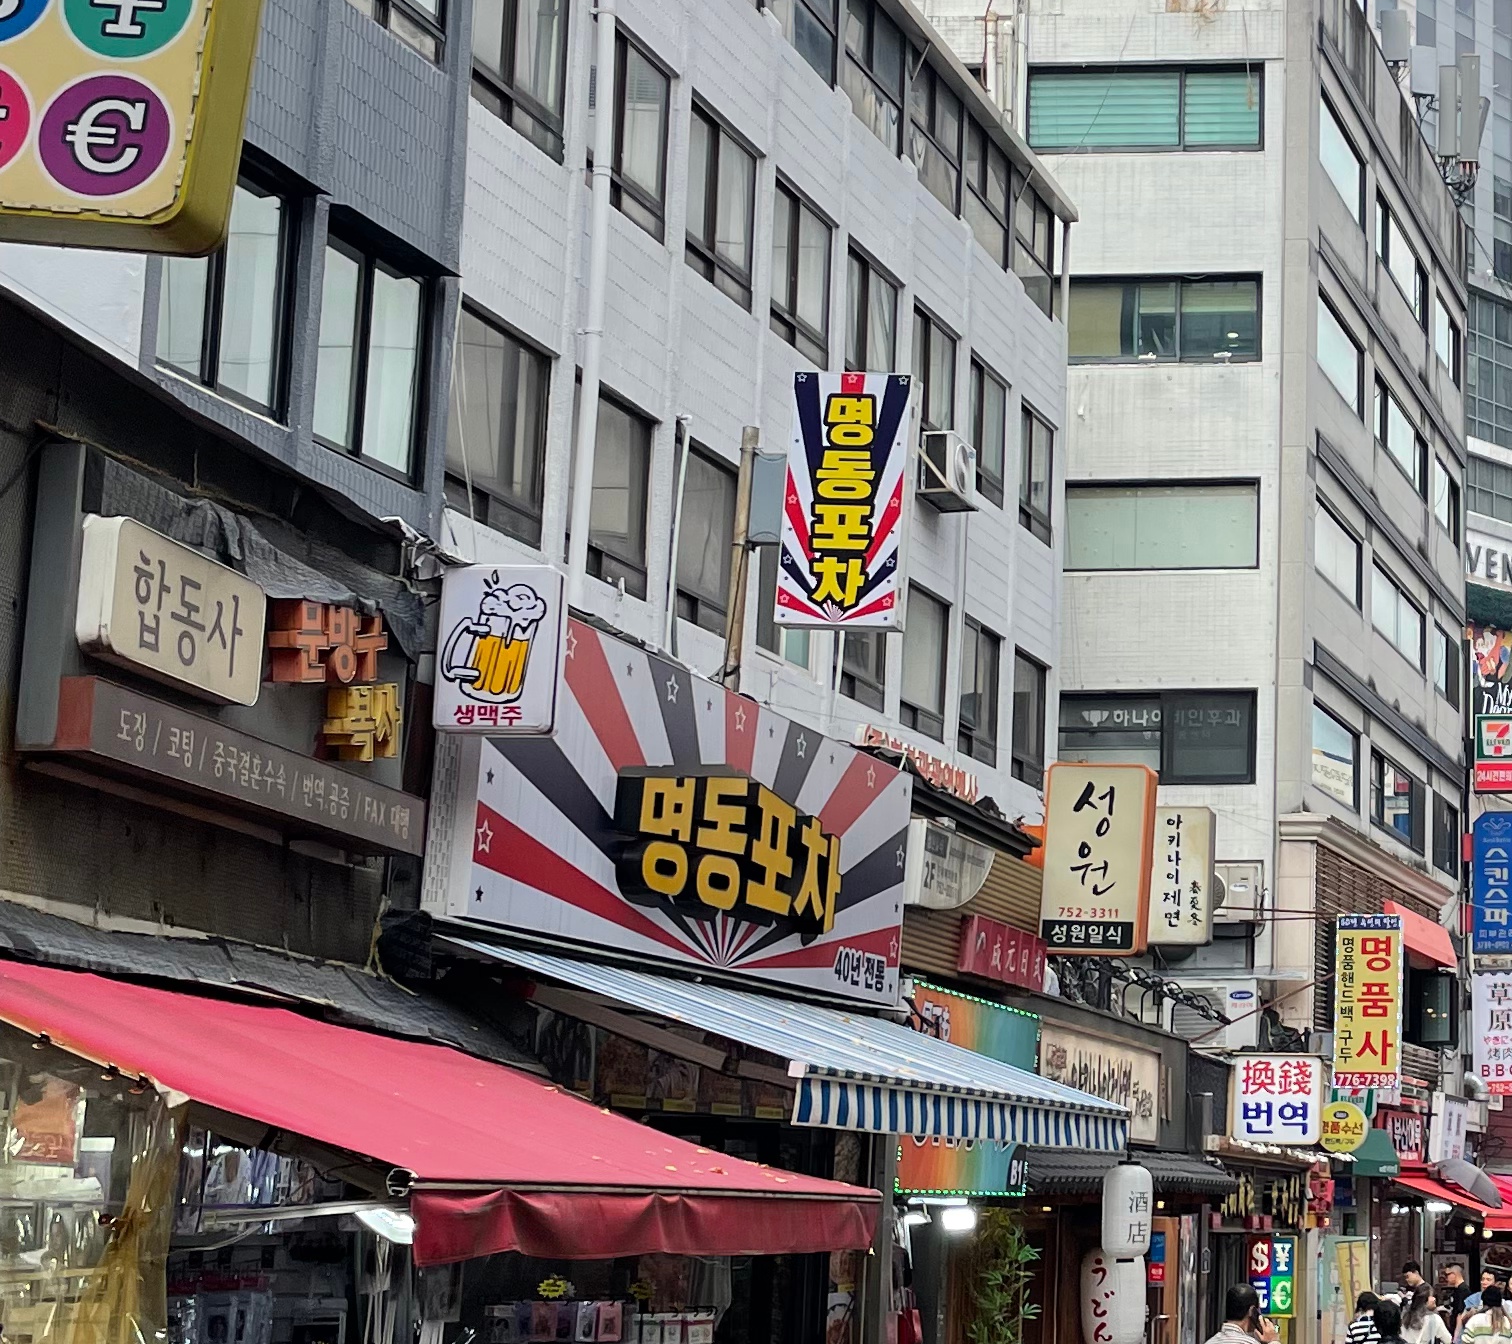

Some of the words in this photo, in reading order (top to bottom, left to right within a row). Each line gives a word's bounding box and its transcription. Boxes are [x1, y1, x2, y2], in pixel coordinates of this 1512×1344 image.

[813, 394, 876, 607] 명동포차
[134, 549, 243, 677] 합동사
[285, 599, 388, 683] 문방구
[332, 683, 401, 762] 복사
[454, 704, 523, 727] 생맥주
[117, 708, 147, 752] 도장
[167, 727, 195, 768] 코팅
[213, 741, 287, 797] 중국결혼수속
[364, 796, 386, 827] FAX
[641, 776, 841, 935] 명동포차
[1070, 780, 1117, 896] 성원
[1163, 814, 1183, 928] 아키나이제면
[1058, 906, 1120, 920] 752-3311
[1484, 847, 1509, 926] 스킨스파
[834, 945, 860, 985] 40년
[863, 953, 887, 992] 전통
[1051, 924, 1122, 945] 성원일식
[1355, 936, 1394, 1066] 명품사
[1242, 1060, 1312, 1096] 換錢
[1337, 1073, 1395, 1086] 776-7398
[1242, 1101, 1309, 1135] 번역
[1010, 1159, 1023, 1186] B1
[1127, 1191, 1149, 1244] 酒店
[1251, 1241, 1269, 1273] $
[1091, 1257, 1115, 1343] うどん
